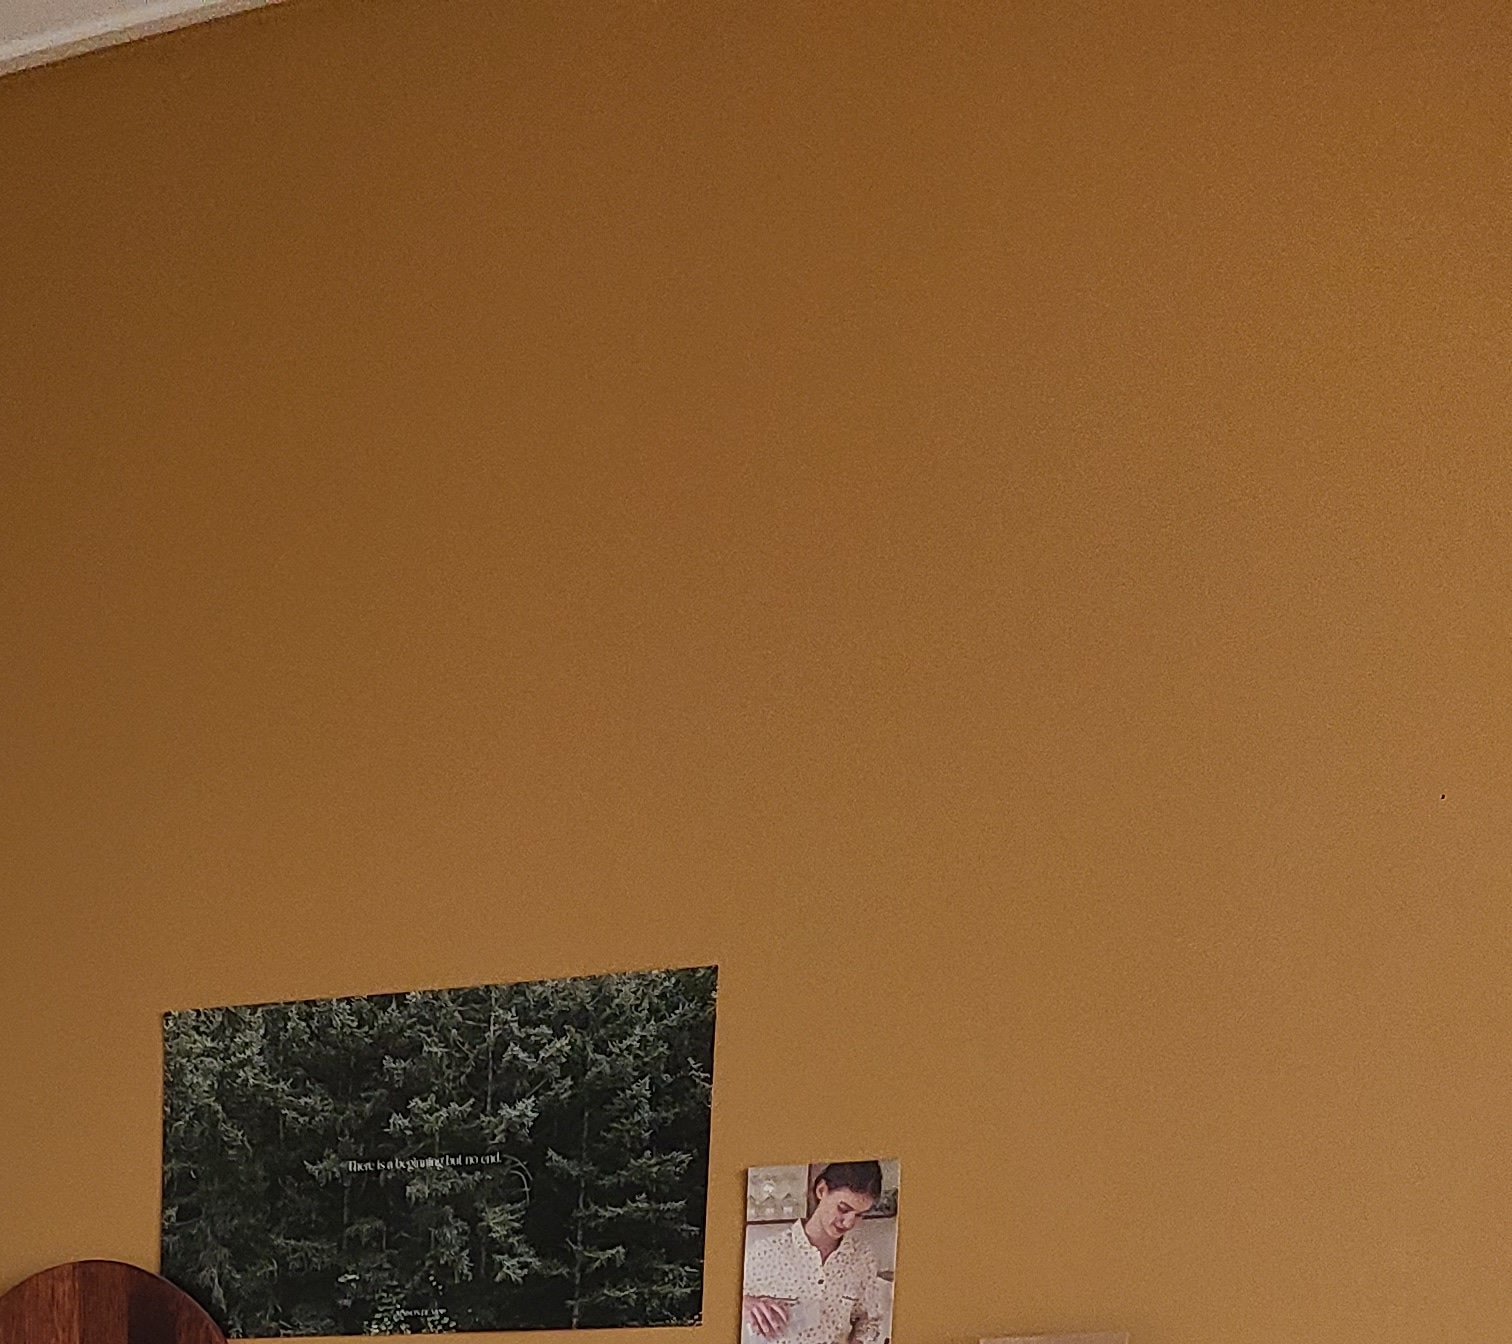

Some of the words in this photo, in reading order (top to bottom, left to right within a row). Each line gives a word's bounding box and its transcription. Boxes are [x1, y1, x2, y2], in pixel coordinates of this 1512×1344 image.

[347, 1160, 375, 1172] There
[377, 1159, 386, 1170] is
[387, 1160, 393, 1169] a
[446, 1154, 462, 1166] but
[465, 1156, 479, 1165] no
